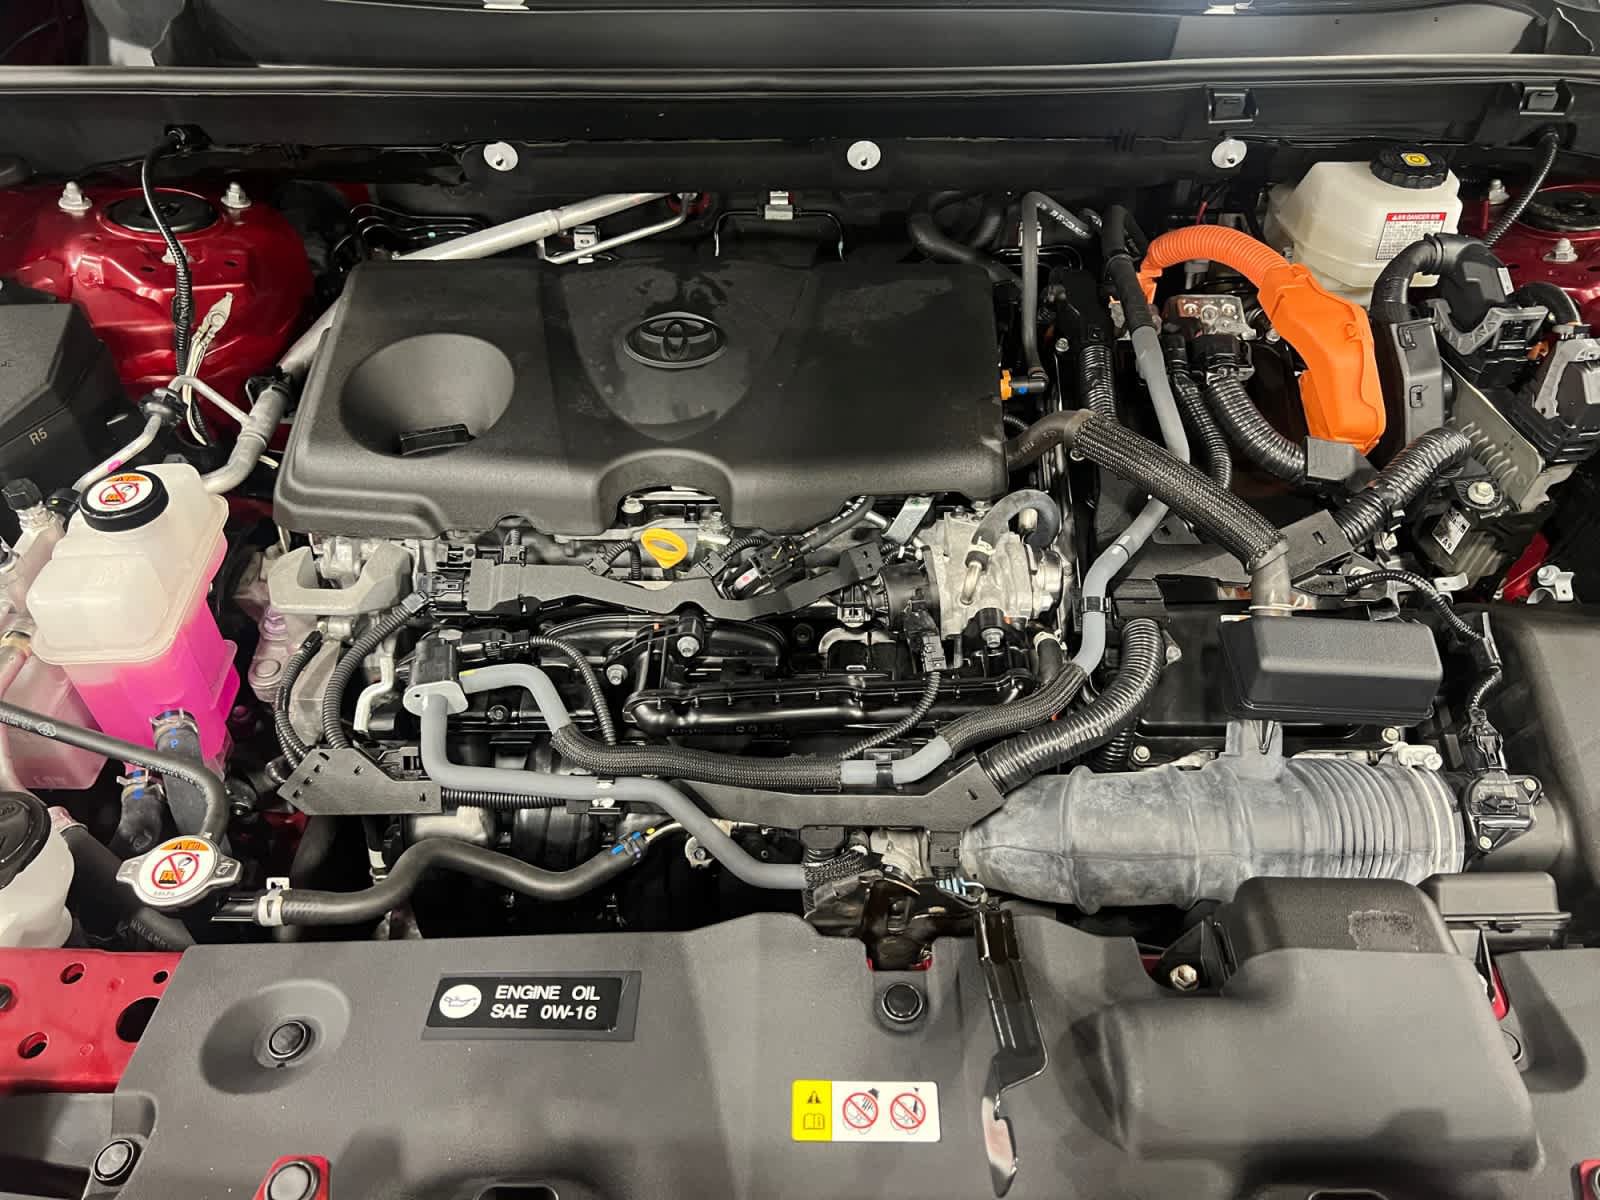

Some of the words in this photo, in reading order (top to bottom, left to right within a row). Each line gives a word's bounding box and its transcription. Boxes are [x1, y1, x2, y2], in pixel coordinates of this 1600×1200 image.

[29, 427, 48, 445] R5
[495, 985, 562, 1000] ENGINE
[571, 985, 601, 1001] OIL
[490, 1003, 529, 1019] SAE
[540, 1004, 597, 1020] 0W-16
